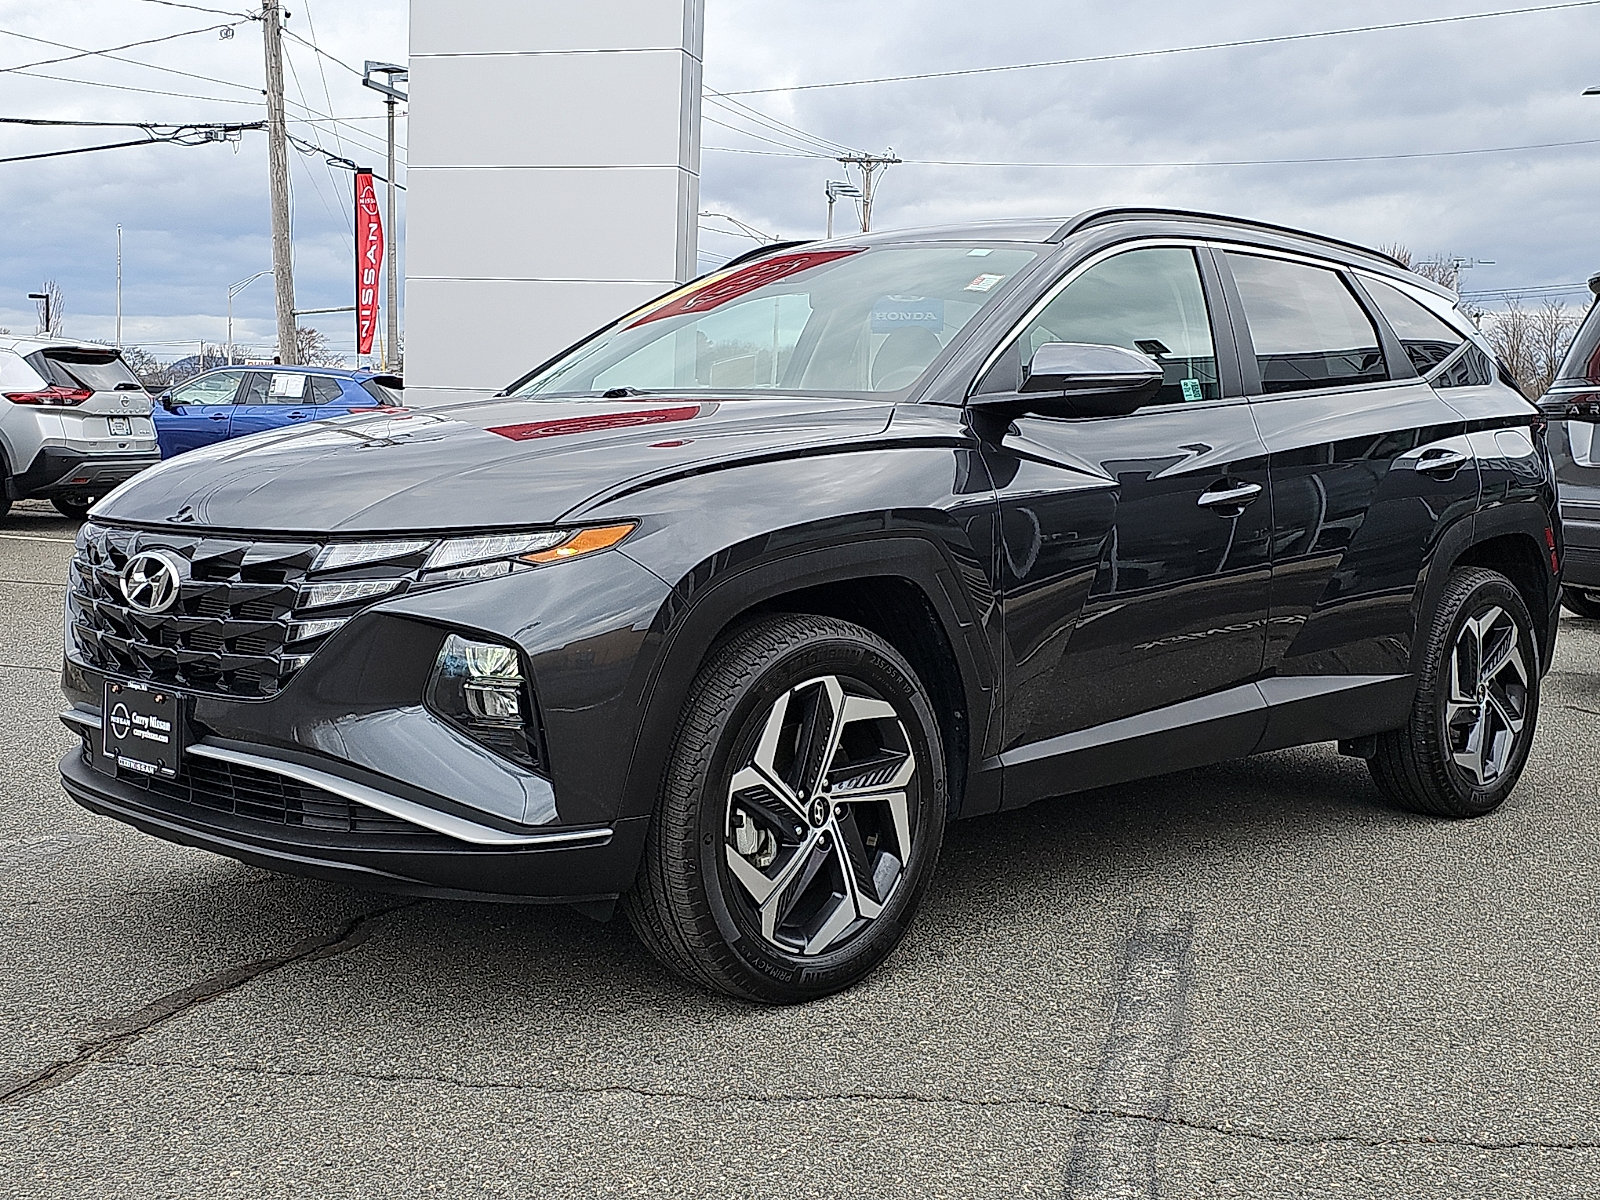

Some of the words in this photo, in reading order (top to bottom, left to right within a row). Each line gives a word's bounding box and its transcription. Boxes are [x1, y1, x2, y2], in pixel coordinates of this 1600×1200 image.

[360, 222, 380, 338] NISSAN
[875, 311, 937, 321] HONDA
[870, 655, 898, 678] 235/55
[896, 675, 904, 683] R
[902, 682, 912, 693] 19
[110, 715, 131, 727] NISSAN
[131, 711, 149, 729] Curry
[149, 715, 171, 732] Nissan
[751, 956, 793, 982] PRIMACY
